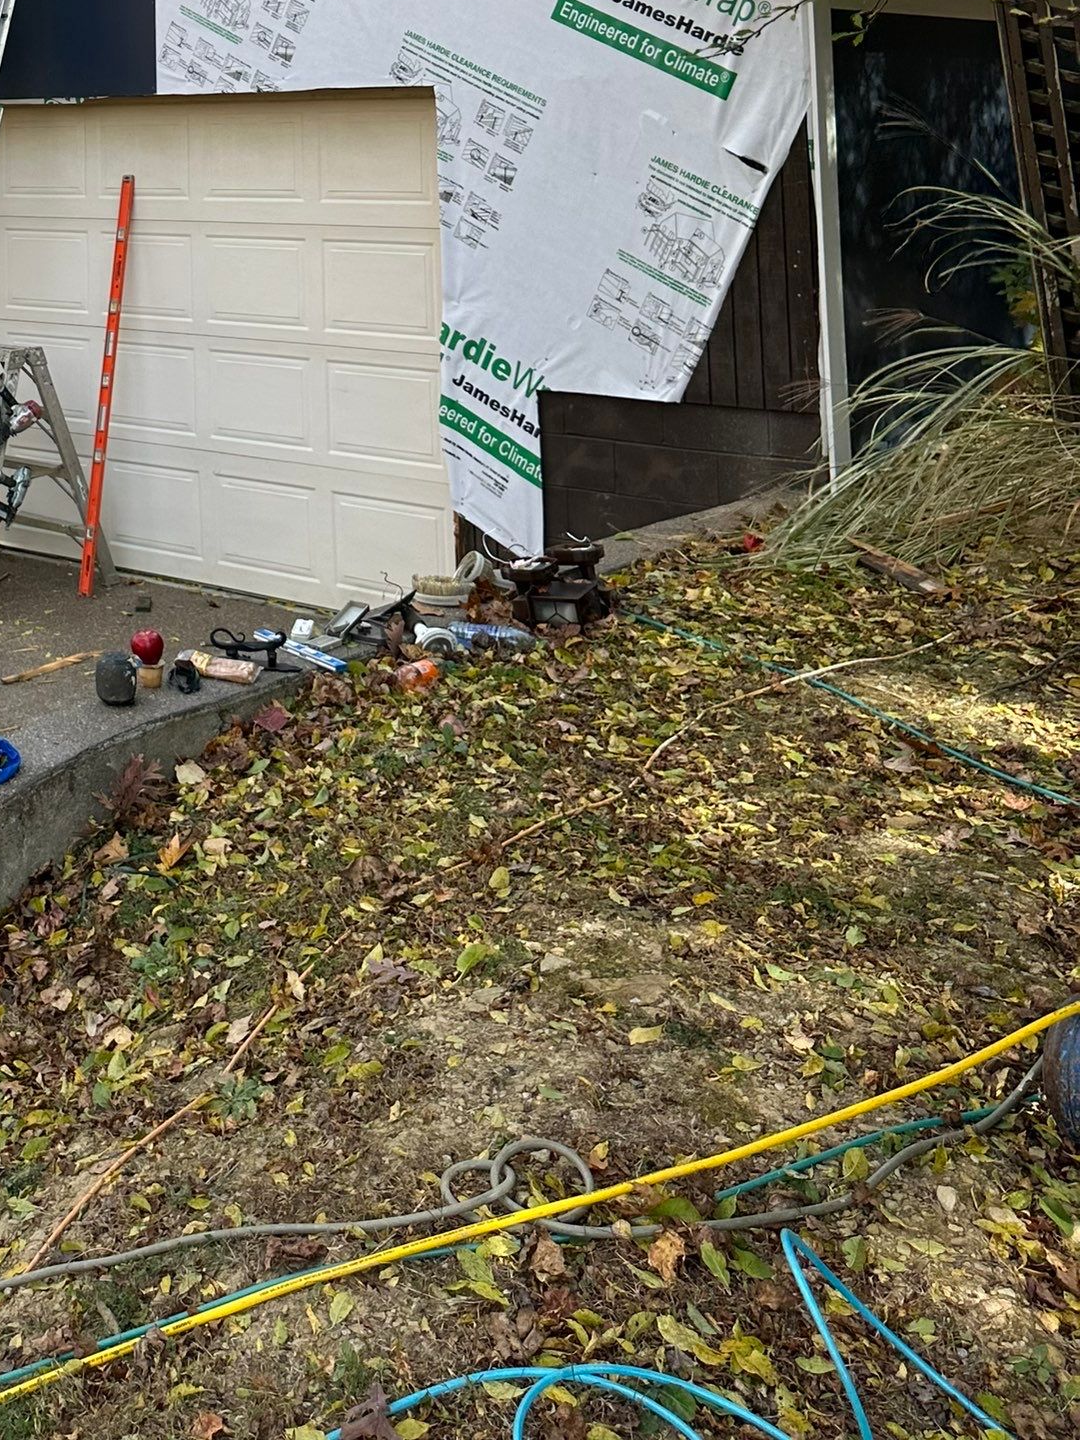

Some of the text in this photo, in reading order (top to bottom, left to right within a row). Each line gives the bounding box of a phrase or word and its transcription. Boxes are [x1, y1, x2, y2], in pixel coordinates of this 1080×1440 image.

[559, 1, 638, 50] Engineered
[641, 38, 663, 67] for
[404, 29, 547, 107] JAMES HARDIE CLEARANCE REQUIREMENTS
[651, 155, 760, 216] JAMES HARDIE CLEARANCE
[439, 321, 551, 399] ardieW
[477, 425, 497, 447] for
